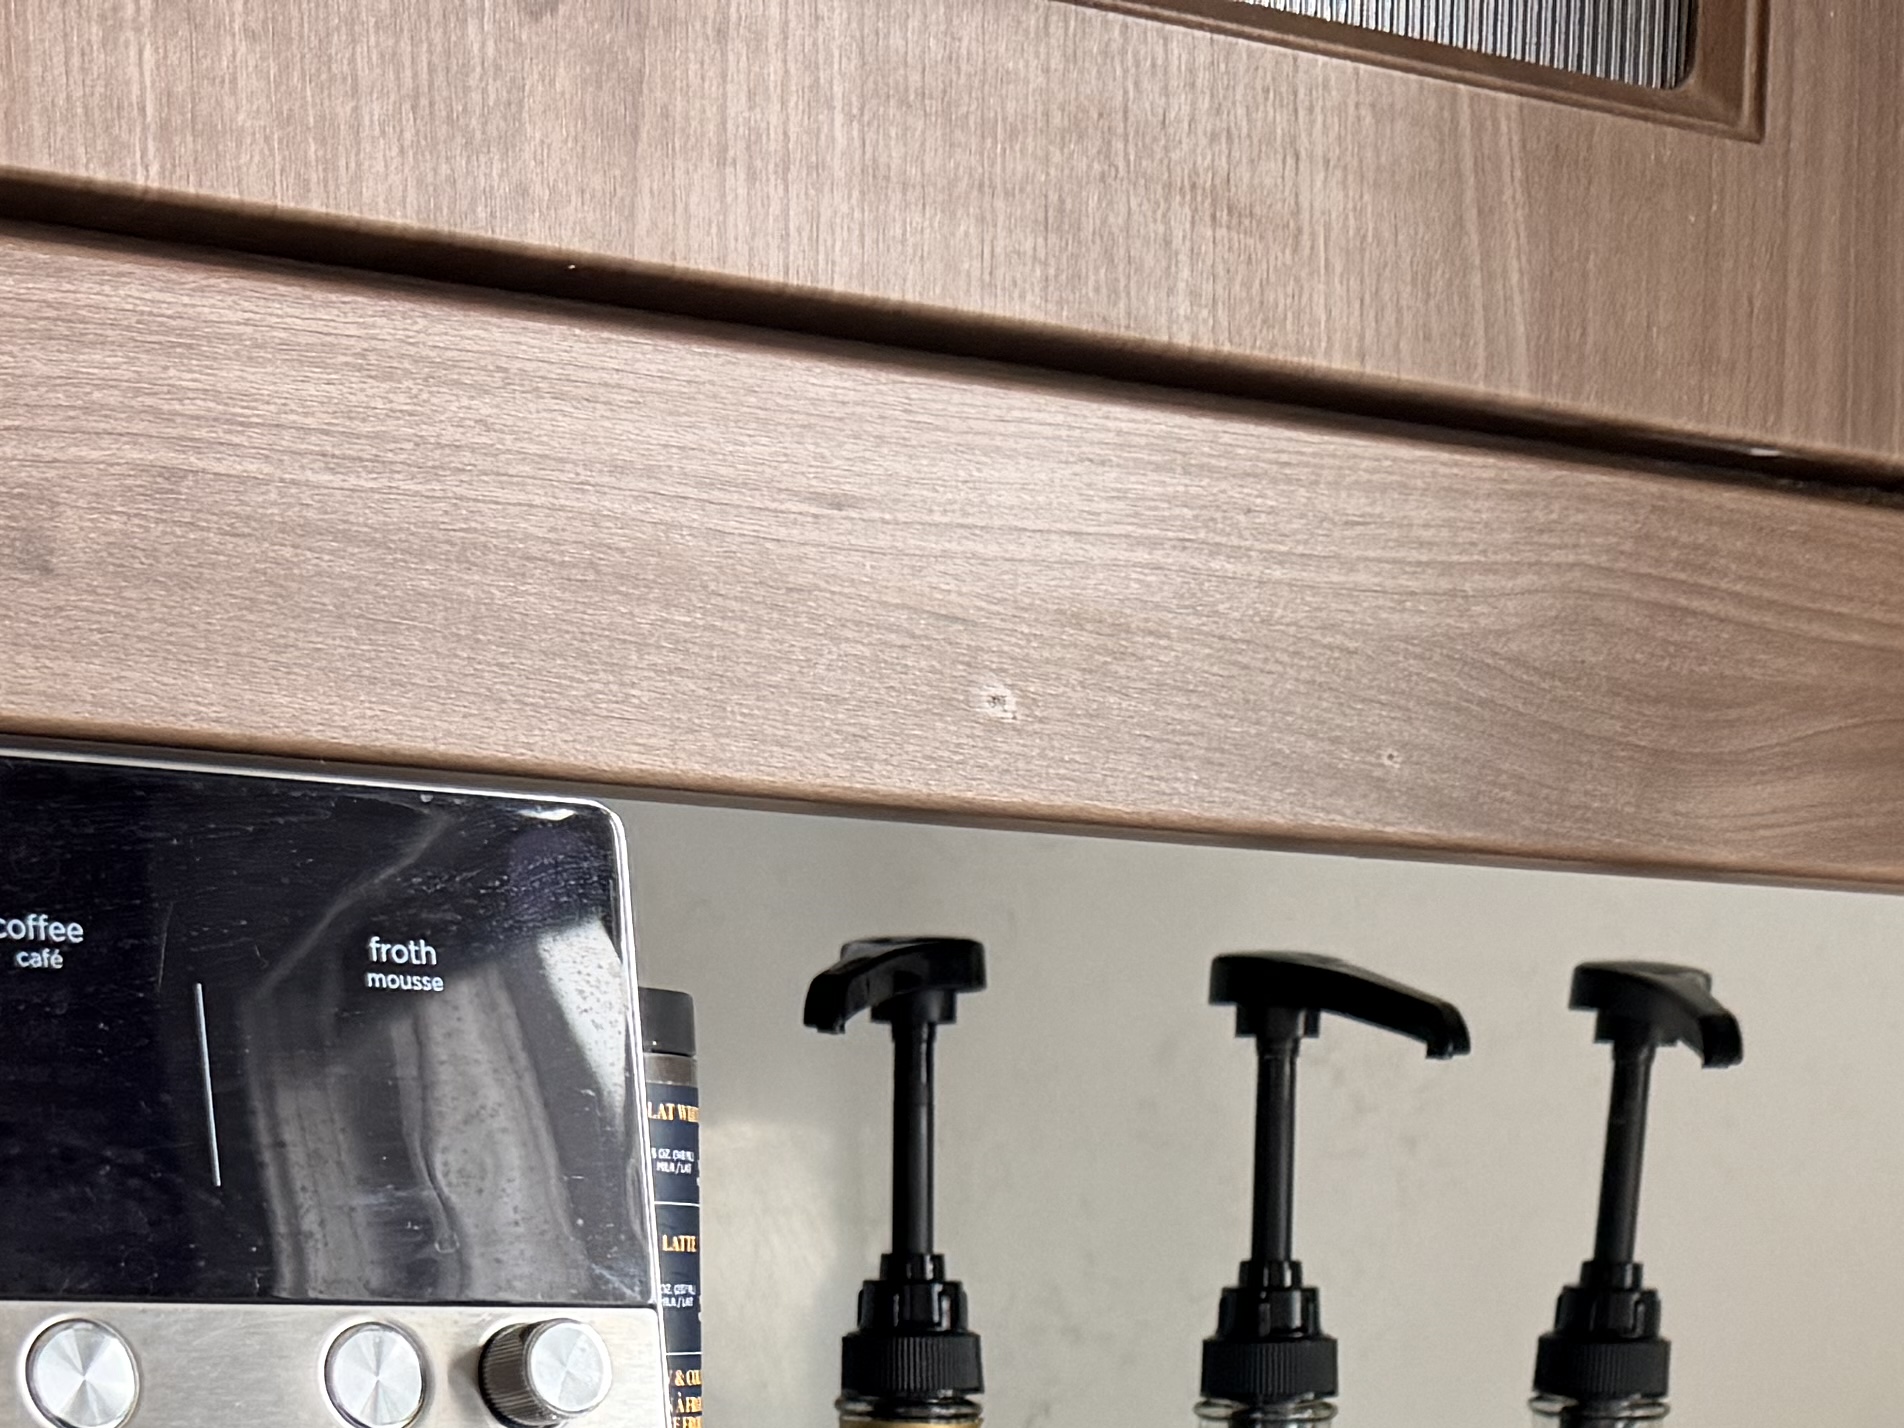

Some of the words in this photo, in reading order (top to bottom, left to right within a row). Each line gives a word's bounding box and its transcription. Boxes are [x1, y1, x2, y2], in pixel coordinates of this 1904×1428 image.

[16, 948, 63, 969] café
[368, 936, 437, 965] froth
[366, 971, 444, 992] mousse
